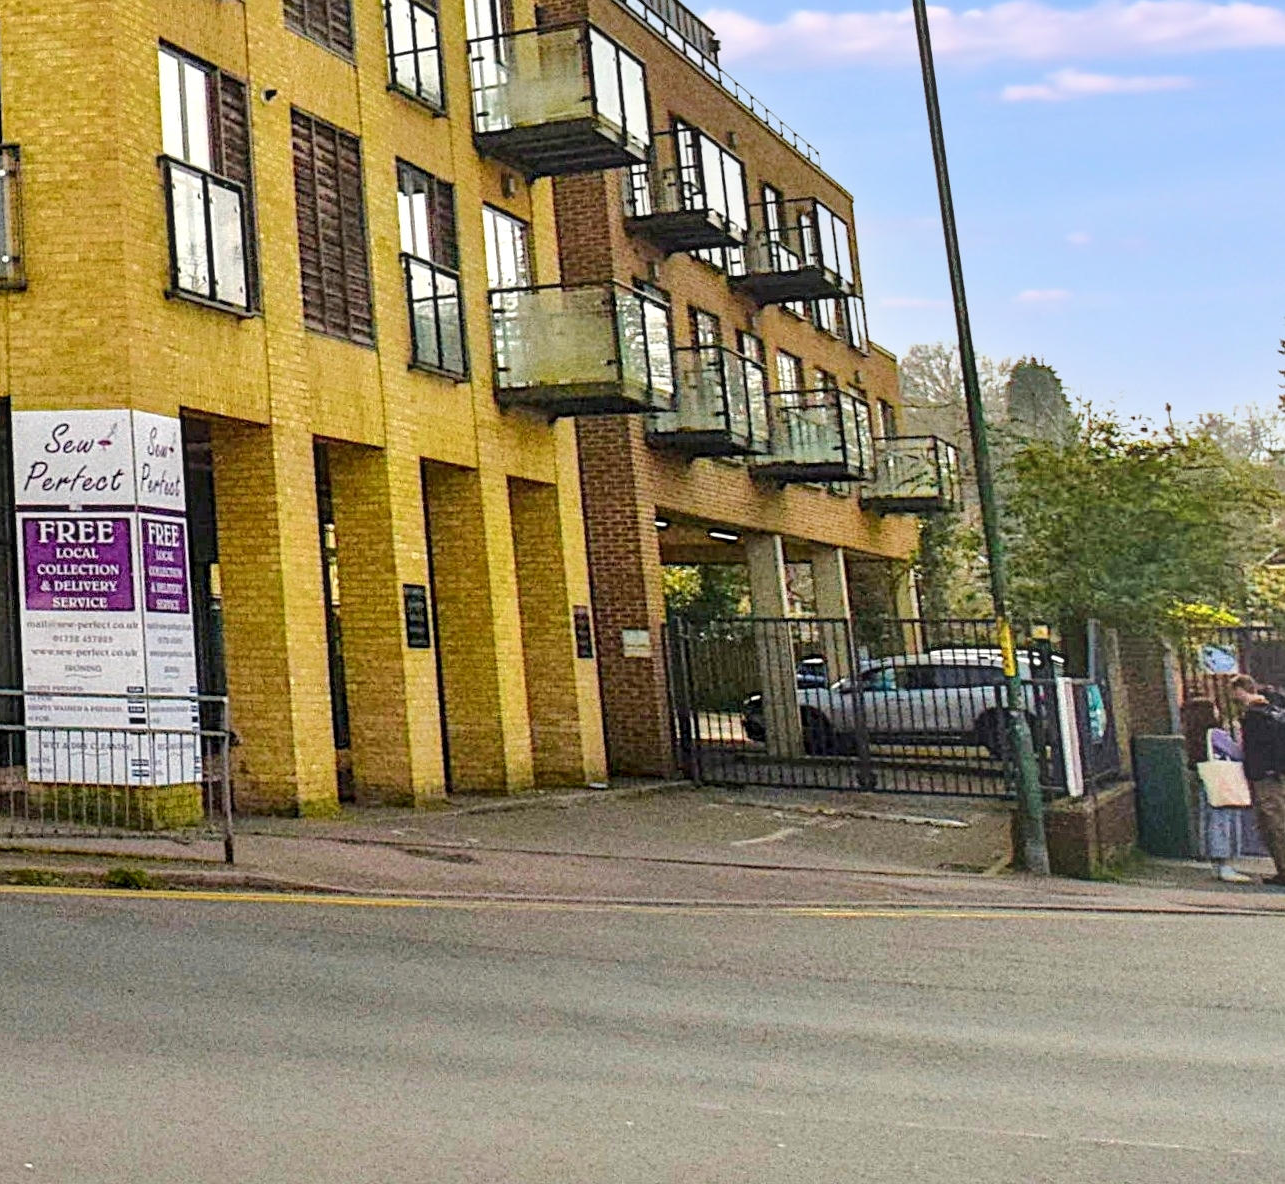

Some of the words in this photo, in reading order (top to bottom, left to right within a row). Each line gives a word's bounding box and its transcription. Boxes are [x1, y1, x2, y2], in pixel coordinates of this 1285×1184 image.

[45, 423, 94, 454] Sew
[24, 461, 125, 492] Perfect
[38, 520, 115, 544] FREE
[148, 522, 180, 547] FREE
[55, 547, 99, 559] LOCAL
[37, 563, 120, 575] COLLECTION
[40, 581, 51, 591] &
[54, 580, 118, 592] DELIVERY
[52, 596, 108, 609] SERVICE
